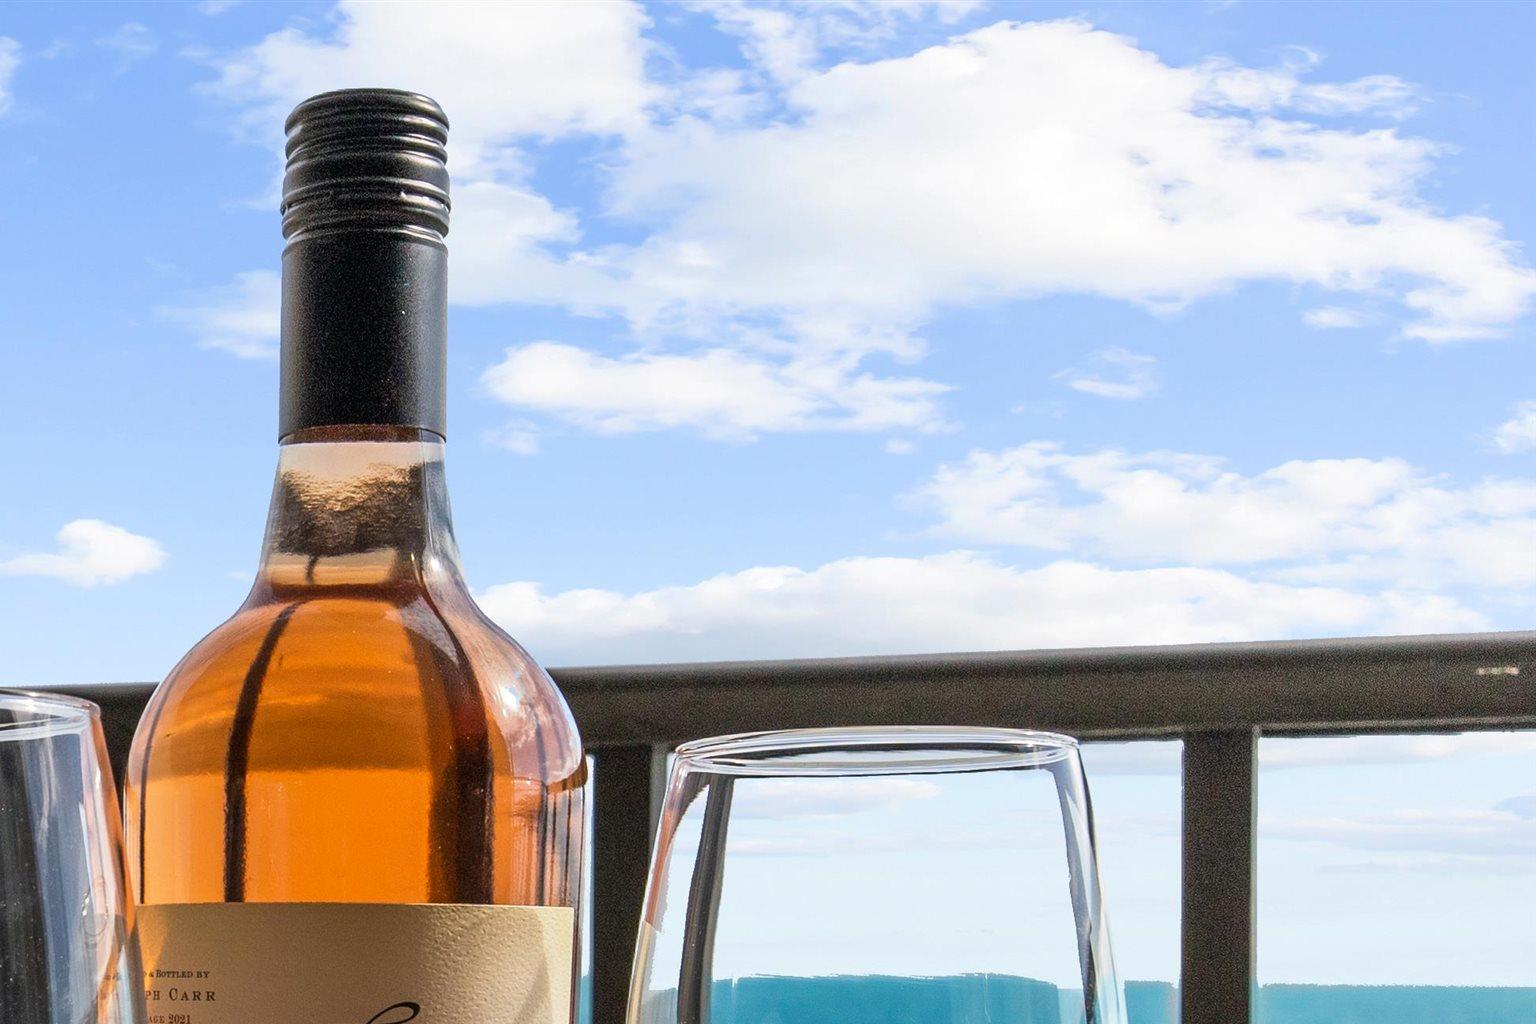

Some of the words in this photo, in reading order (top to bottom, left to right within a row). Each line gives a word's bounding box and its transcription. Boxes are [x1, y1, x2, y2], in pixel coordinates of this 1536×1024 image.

[197, 970, 210, 978] BY
[169, 987, 216, 1001] CARR
[168, 1013, 191, 1024] 2021
